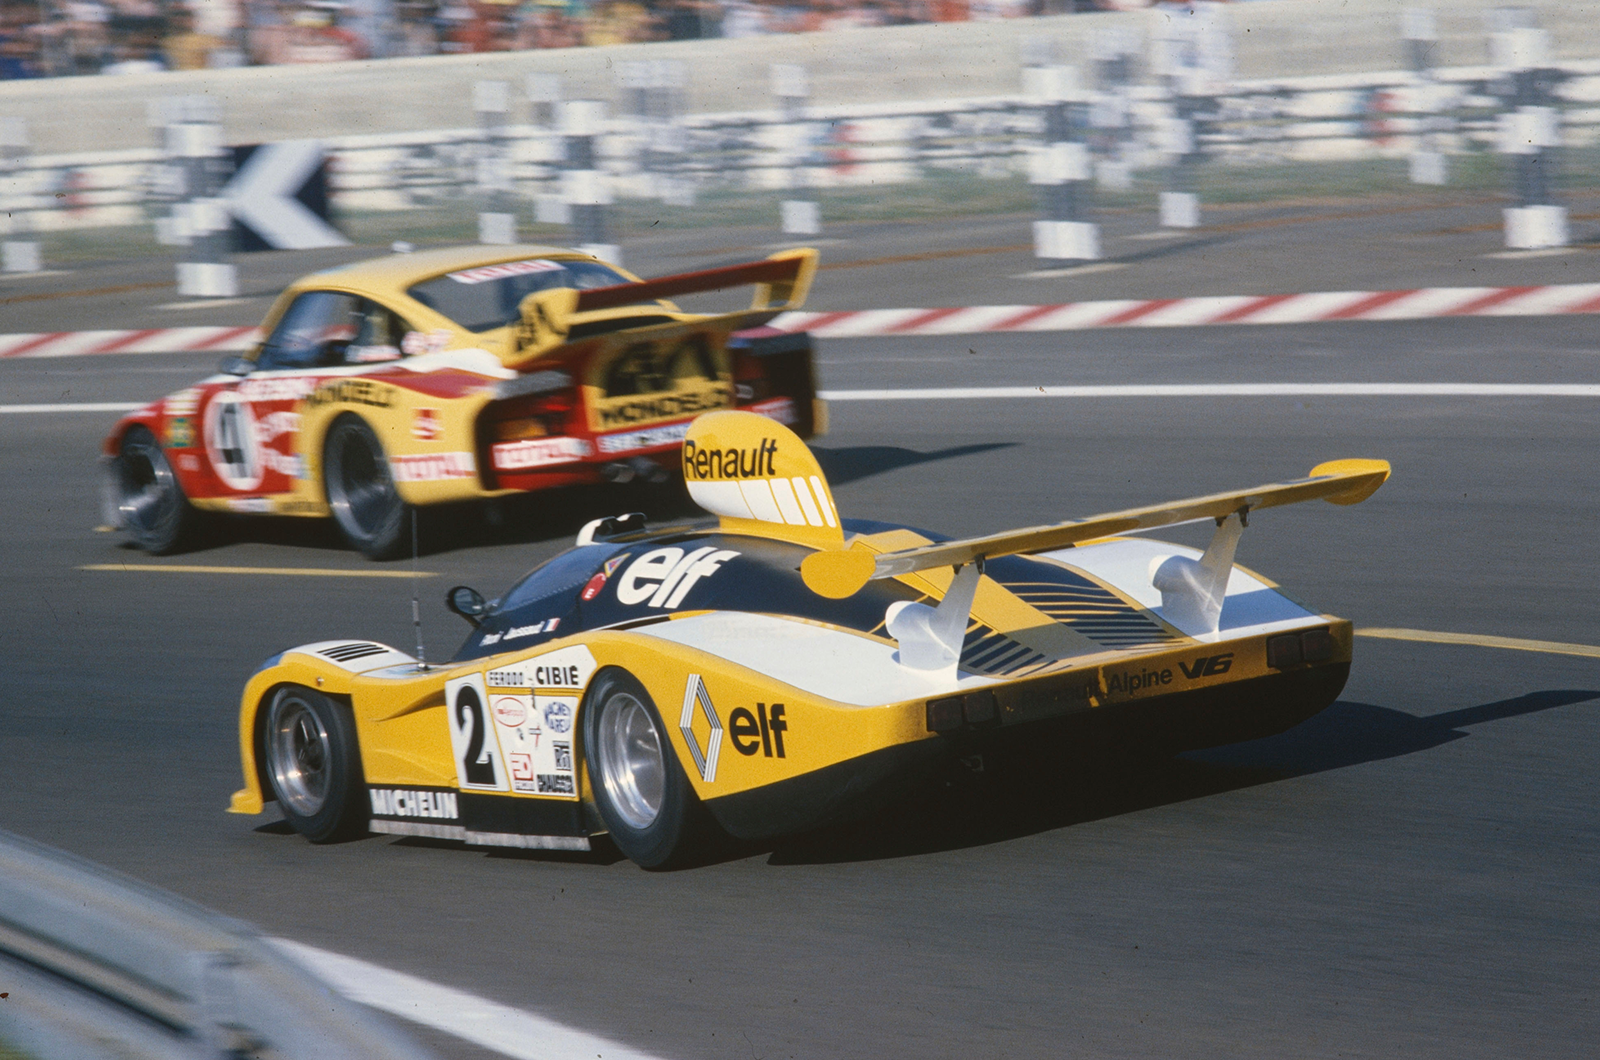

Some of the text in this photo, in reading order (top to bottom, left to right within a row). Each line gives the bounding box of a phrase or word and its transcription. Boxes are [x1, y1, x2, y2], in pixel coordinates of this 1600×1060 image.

[685, 437, 778, 479] Renault
[616, 546, 742, 608] elf
[1107, 668, 1173, 697] Alpine
[1178, 653, 1234, 680] V6
[455, 684, 497, 786] 2
[729, 702, 788, 759] elf
[369, 788, 459, 819] MICHELIN
